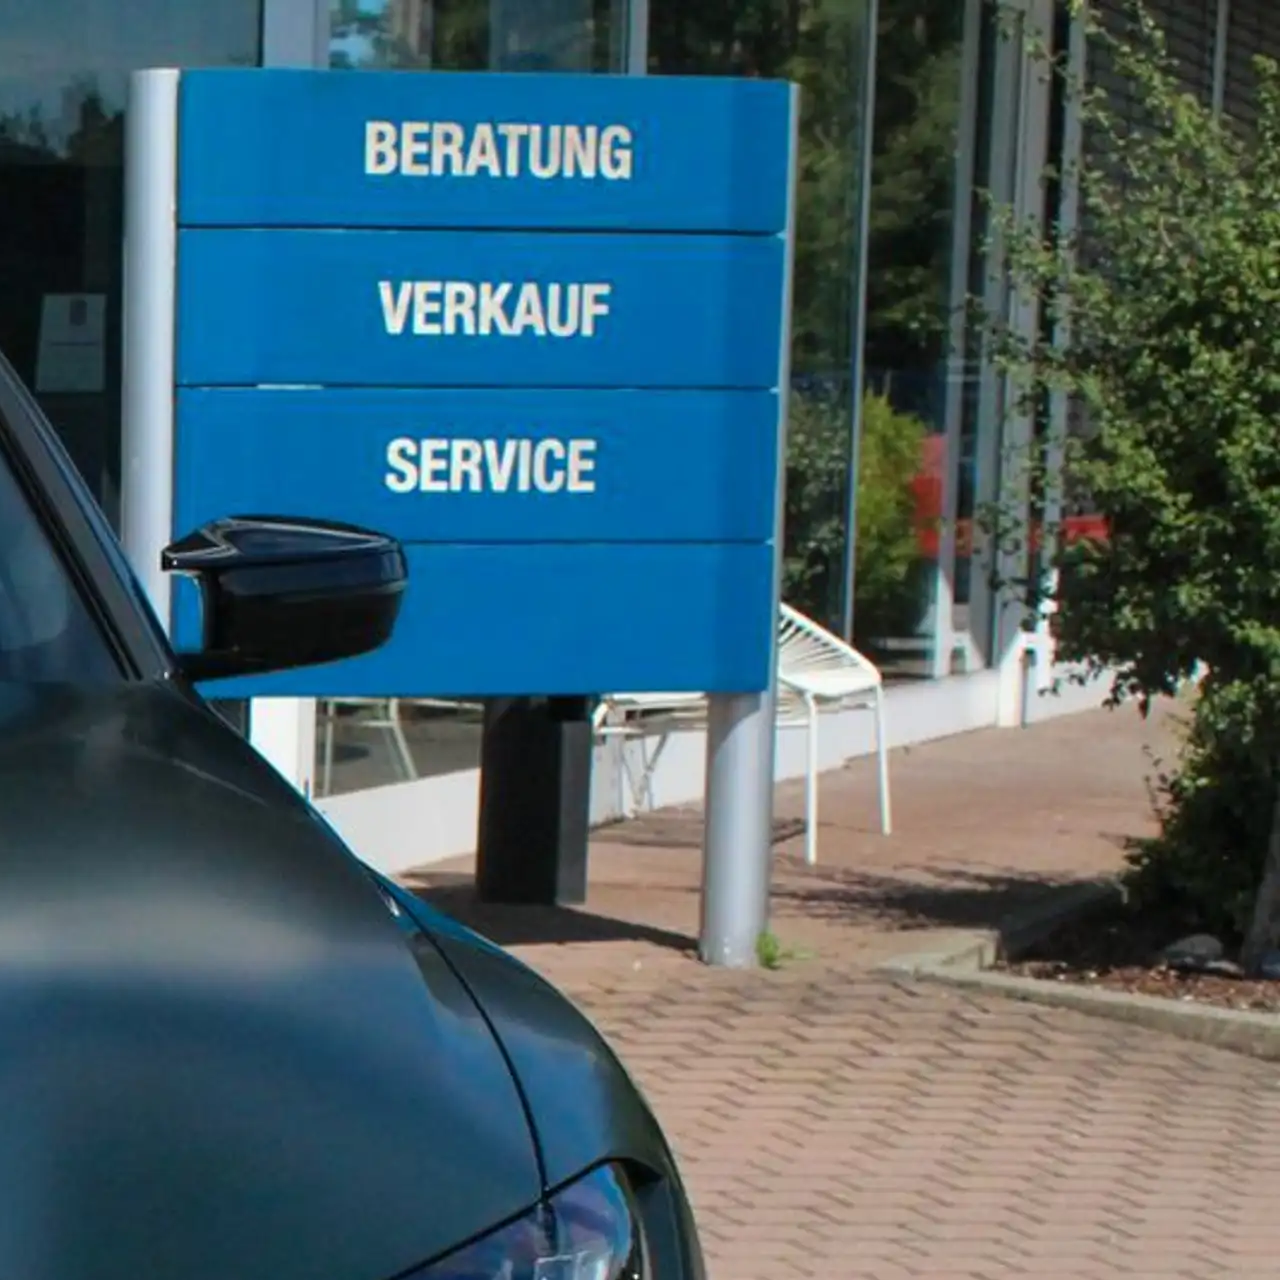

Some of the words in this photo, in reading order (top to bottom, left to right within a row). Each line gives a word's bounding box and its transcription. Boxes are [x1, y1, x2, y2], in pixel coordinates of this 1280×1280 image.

[364, 120, 633, 181] BERATUNG
[377, 280, 612, 338] VERKAUF
[384, 437, 597, 493] SERVICE
